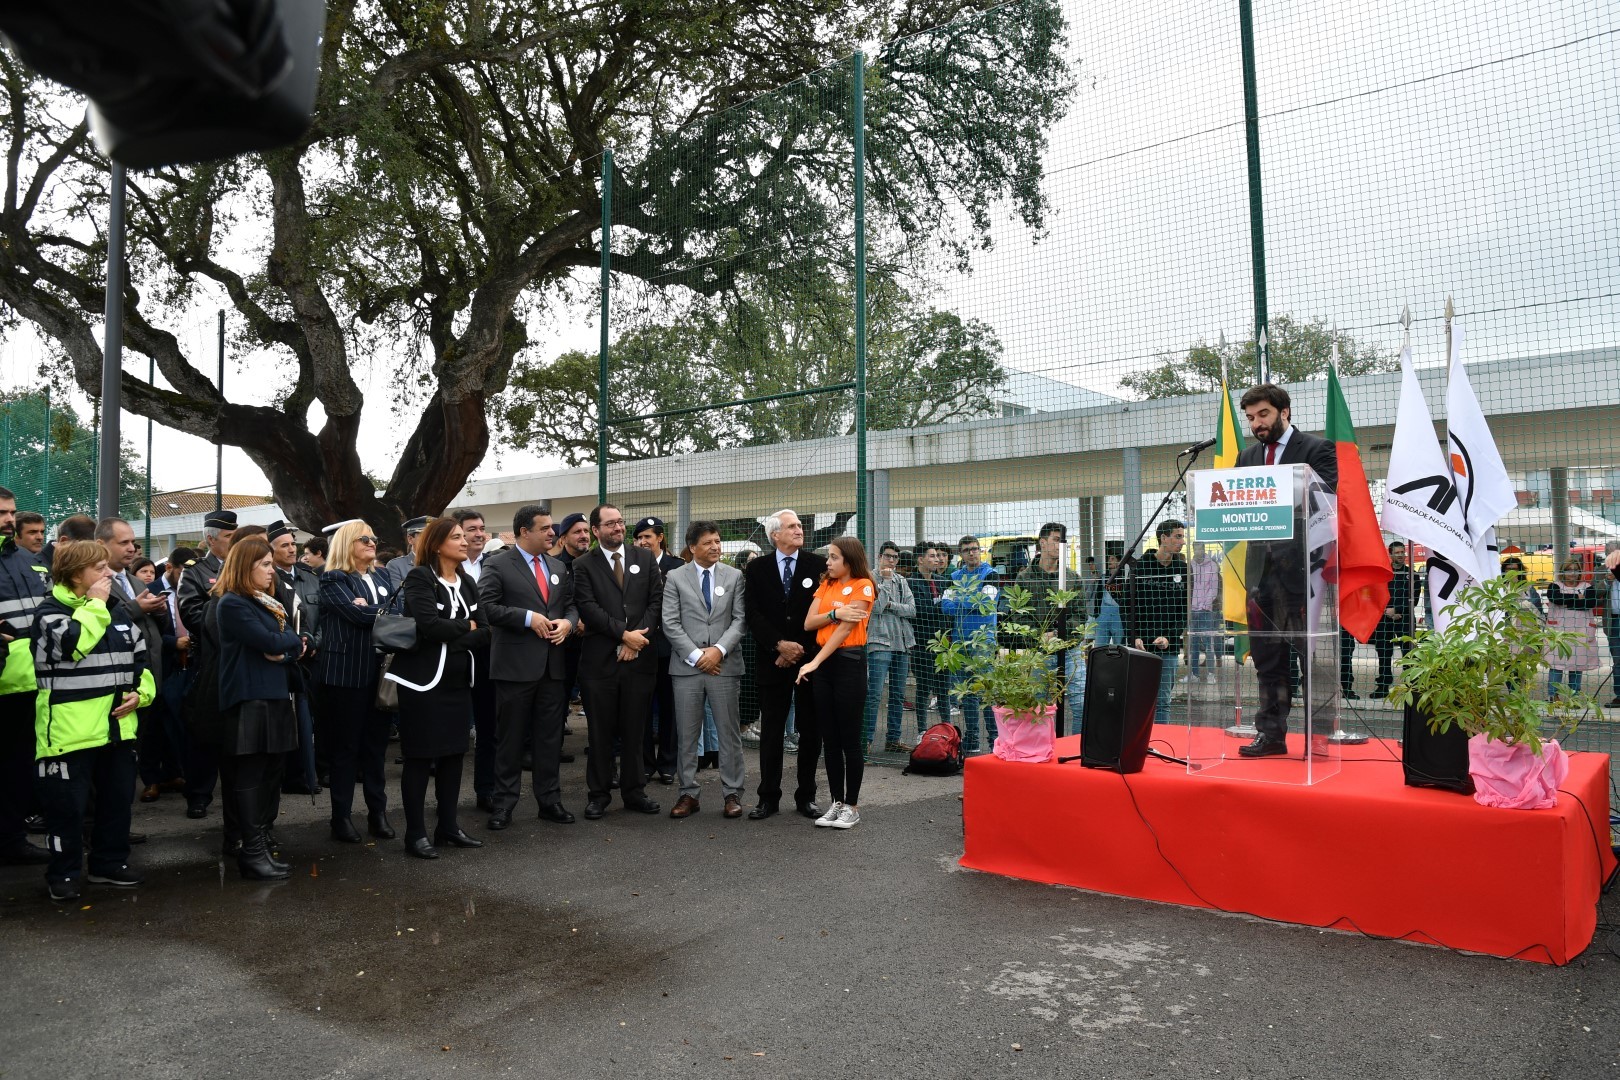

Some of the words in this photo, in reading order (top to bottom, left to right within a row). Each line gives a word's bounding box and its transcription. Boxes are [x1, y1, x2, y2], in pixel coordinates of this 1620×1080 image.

[1226, 476, 1277, 490] TERRA
[1222, 512, 1269, 524] MONTIJO
[1387, 498, 1429, 520] AUTORIDADE
[1428, 515, 1465, 543] NACIONAL
